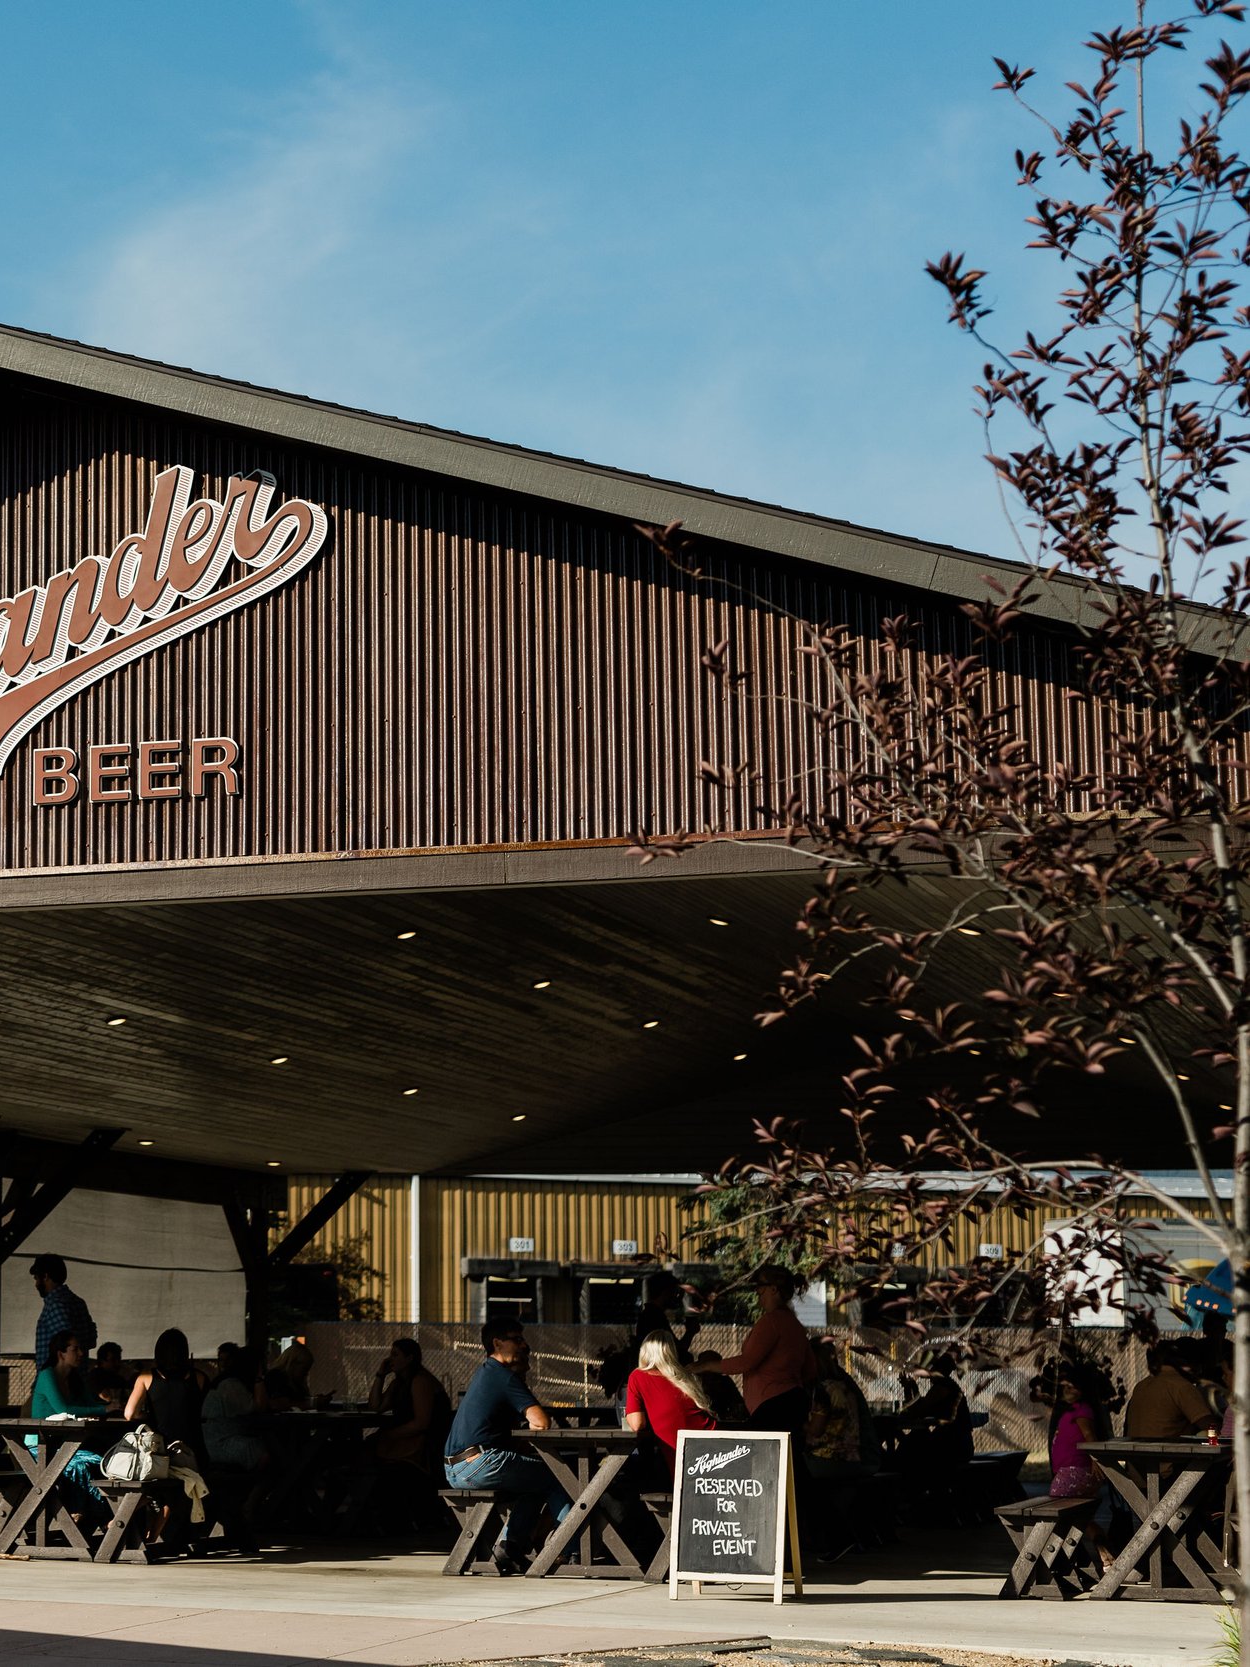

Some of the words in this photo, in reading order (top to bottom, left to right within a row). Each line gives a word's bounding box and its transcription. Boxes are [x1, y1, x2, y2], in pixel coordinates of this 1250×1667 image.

[33, 736, 241, 807] BEER
[513, 1239, 530, 1249] 301
[687, 1444, 751, 1475] Highlander
[694, 1477, 763, 1497] RESERVED
[716, 1498, 738, 1513] FOR
[691, 1518, 743, 1537] PRIVATE
[712, 1538, 756, 1557] EVENT
